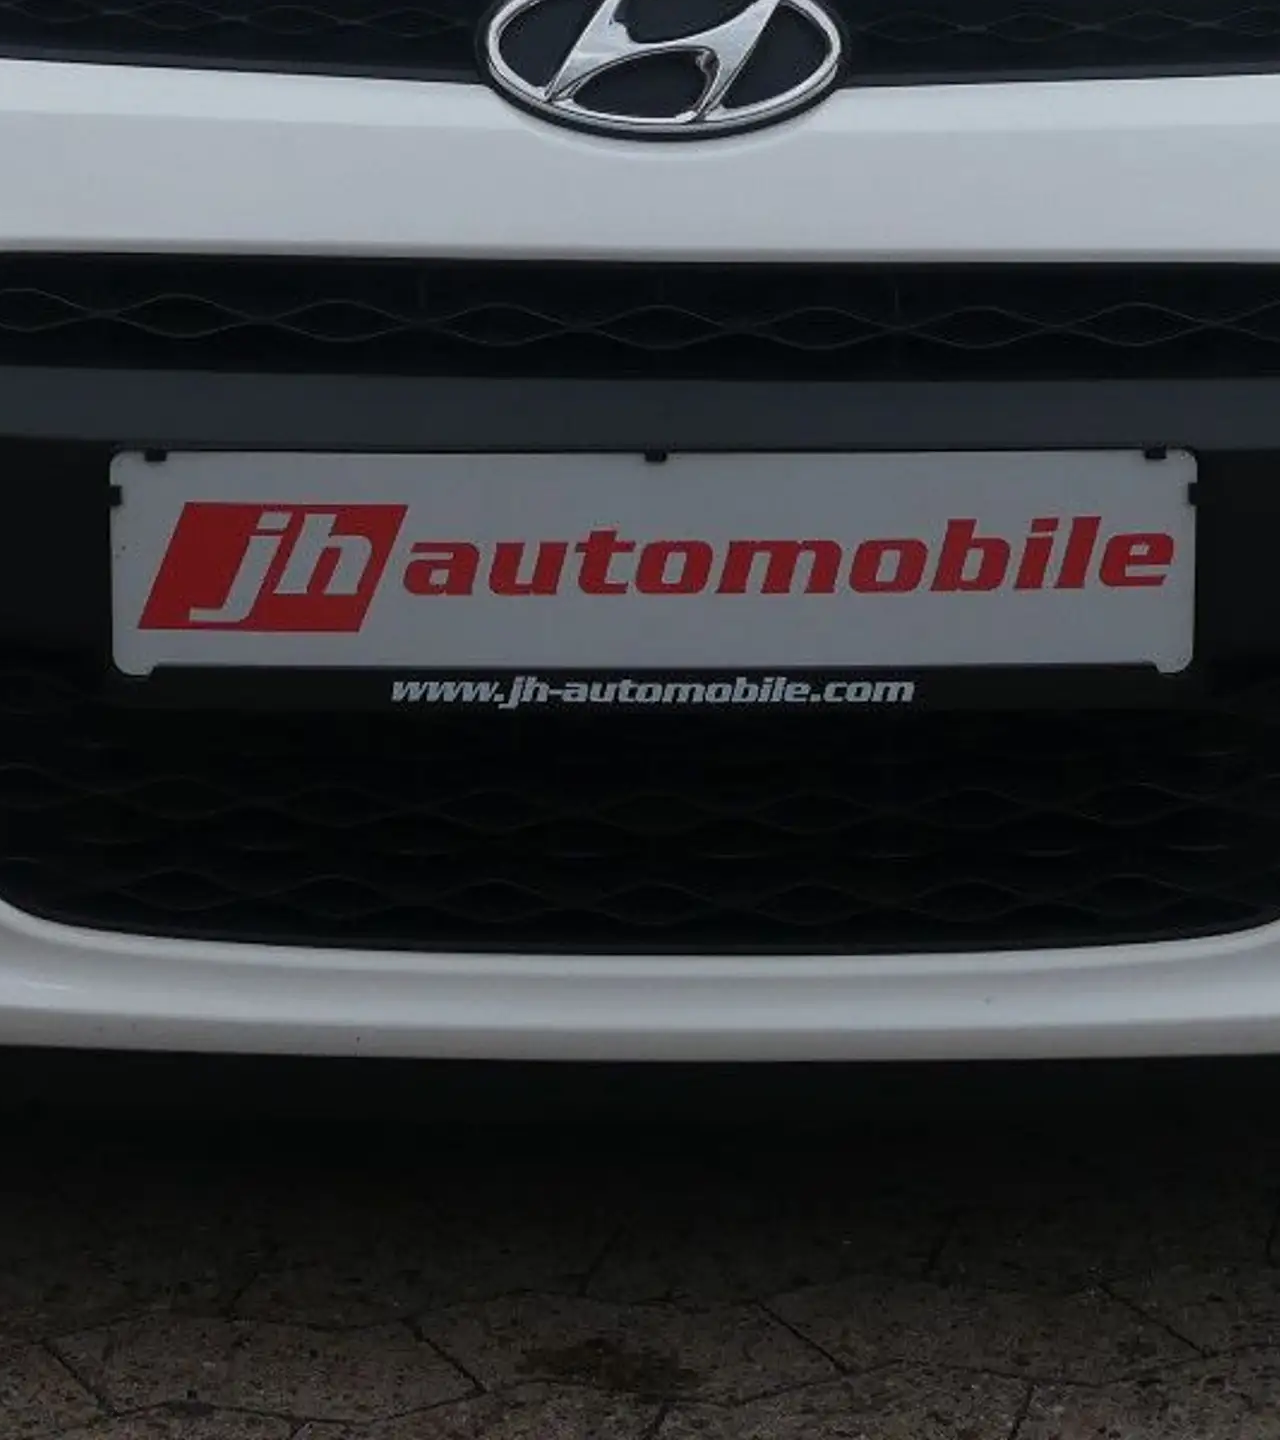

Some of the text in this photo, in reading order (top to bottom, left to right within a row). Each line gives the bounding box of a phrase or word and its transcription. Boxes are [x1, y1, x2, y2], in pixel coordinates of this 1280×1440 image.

[188, 511, 1175, 623] jh automobile
[391, 675, 916, 709] www.jh-automobile.com
